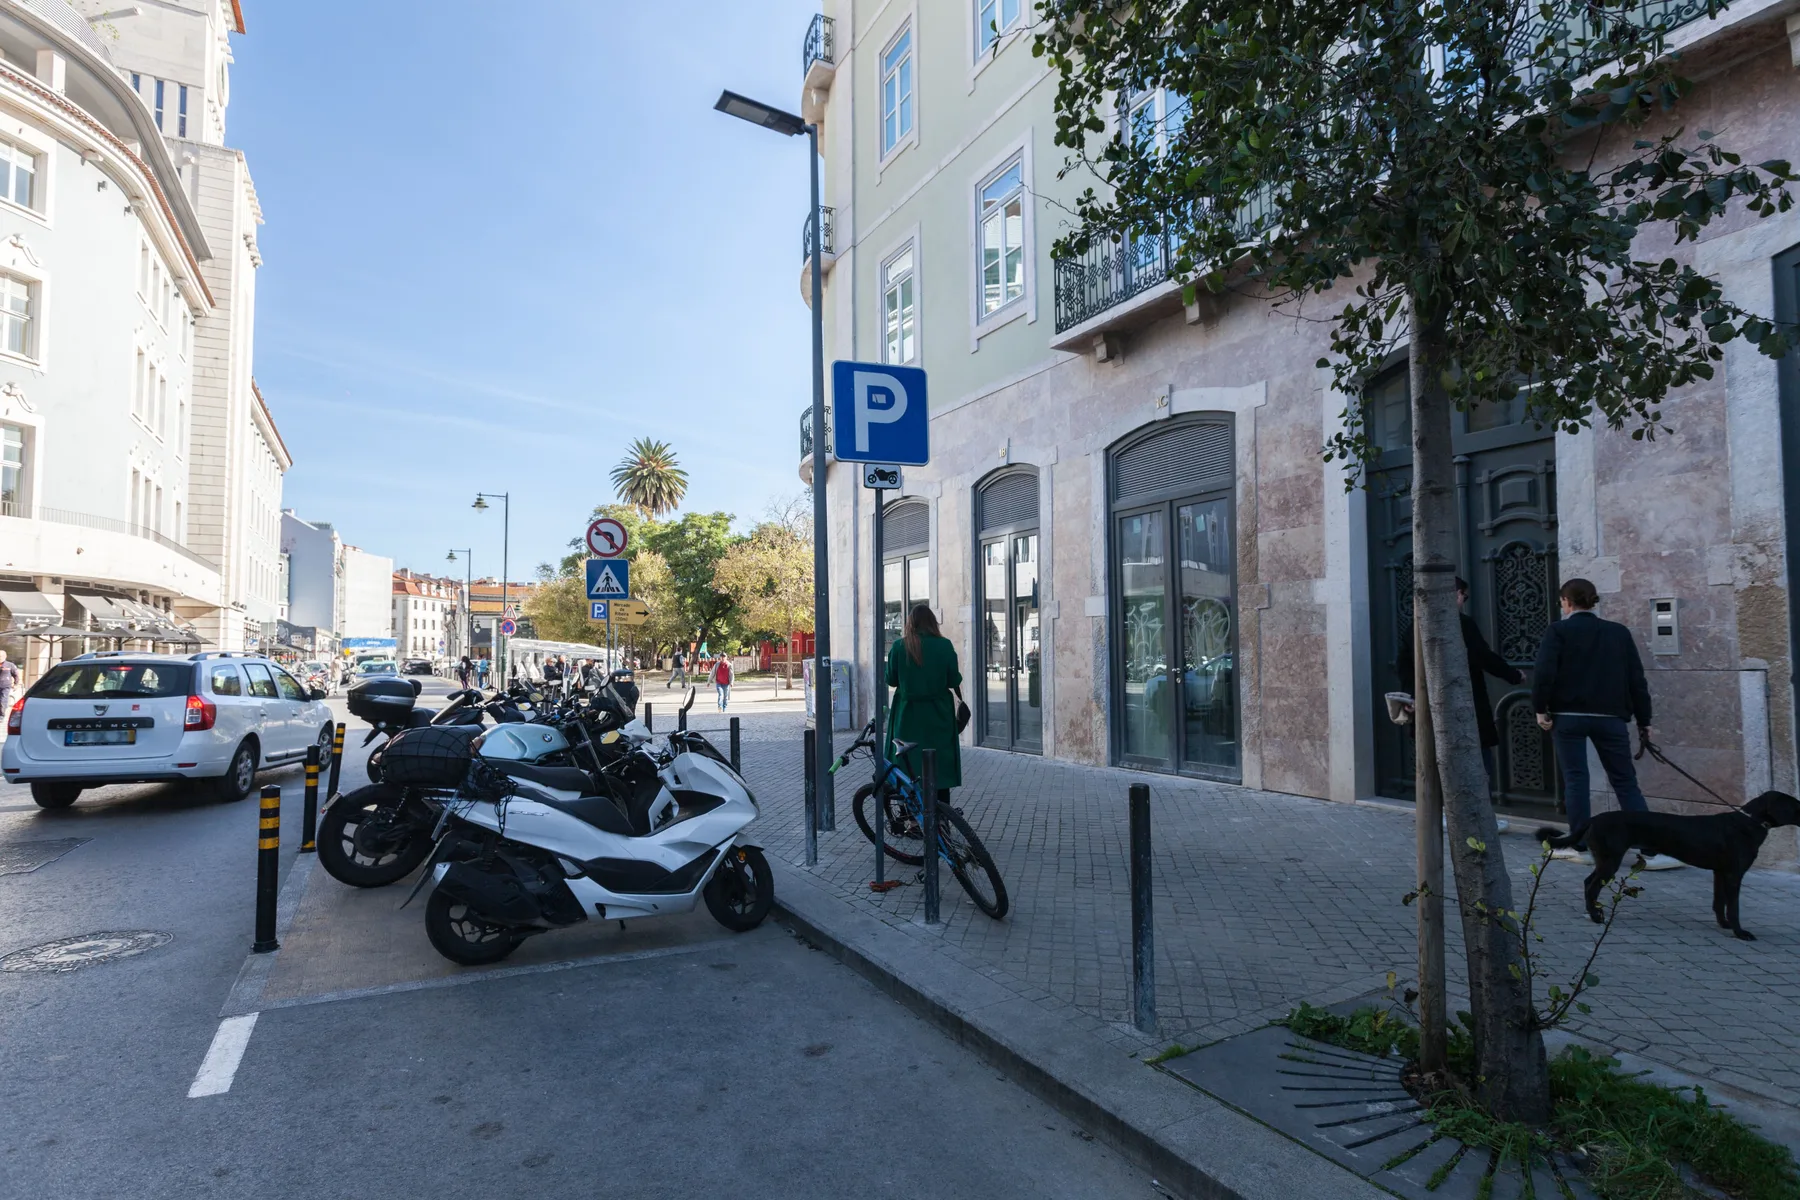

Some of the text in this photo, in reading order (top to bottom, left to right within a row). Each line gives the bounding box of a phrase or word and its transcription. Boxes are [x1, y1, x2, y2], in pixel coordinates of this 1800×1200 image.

[1156, 394, 1169, 409] 1C
[853, 370, 908, 452] P
[594, 604, 604, 617] P
